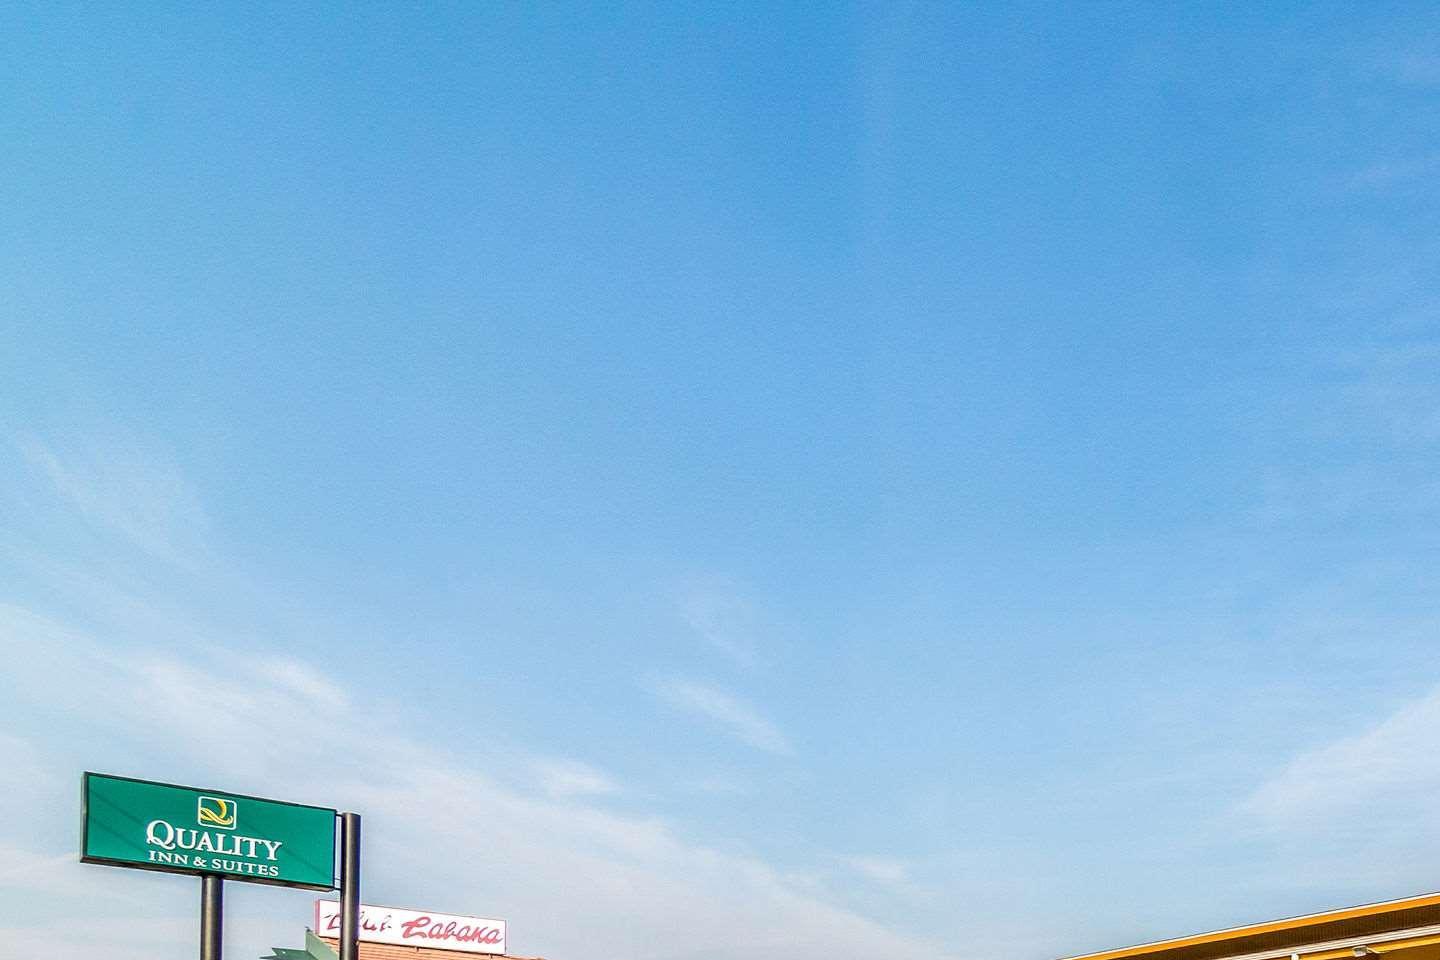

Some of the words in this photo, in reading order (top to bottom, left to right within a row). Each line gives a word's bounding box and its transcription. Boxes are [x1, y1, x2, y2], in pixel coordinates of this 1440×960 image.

[146, 819, 283, 861] QUALITY
[148, 850, 189, 865] INN
[193, 856, 207, 868] &
[211, 858, 279, 877] SUITES
